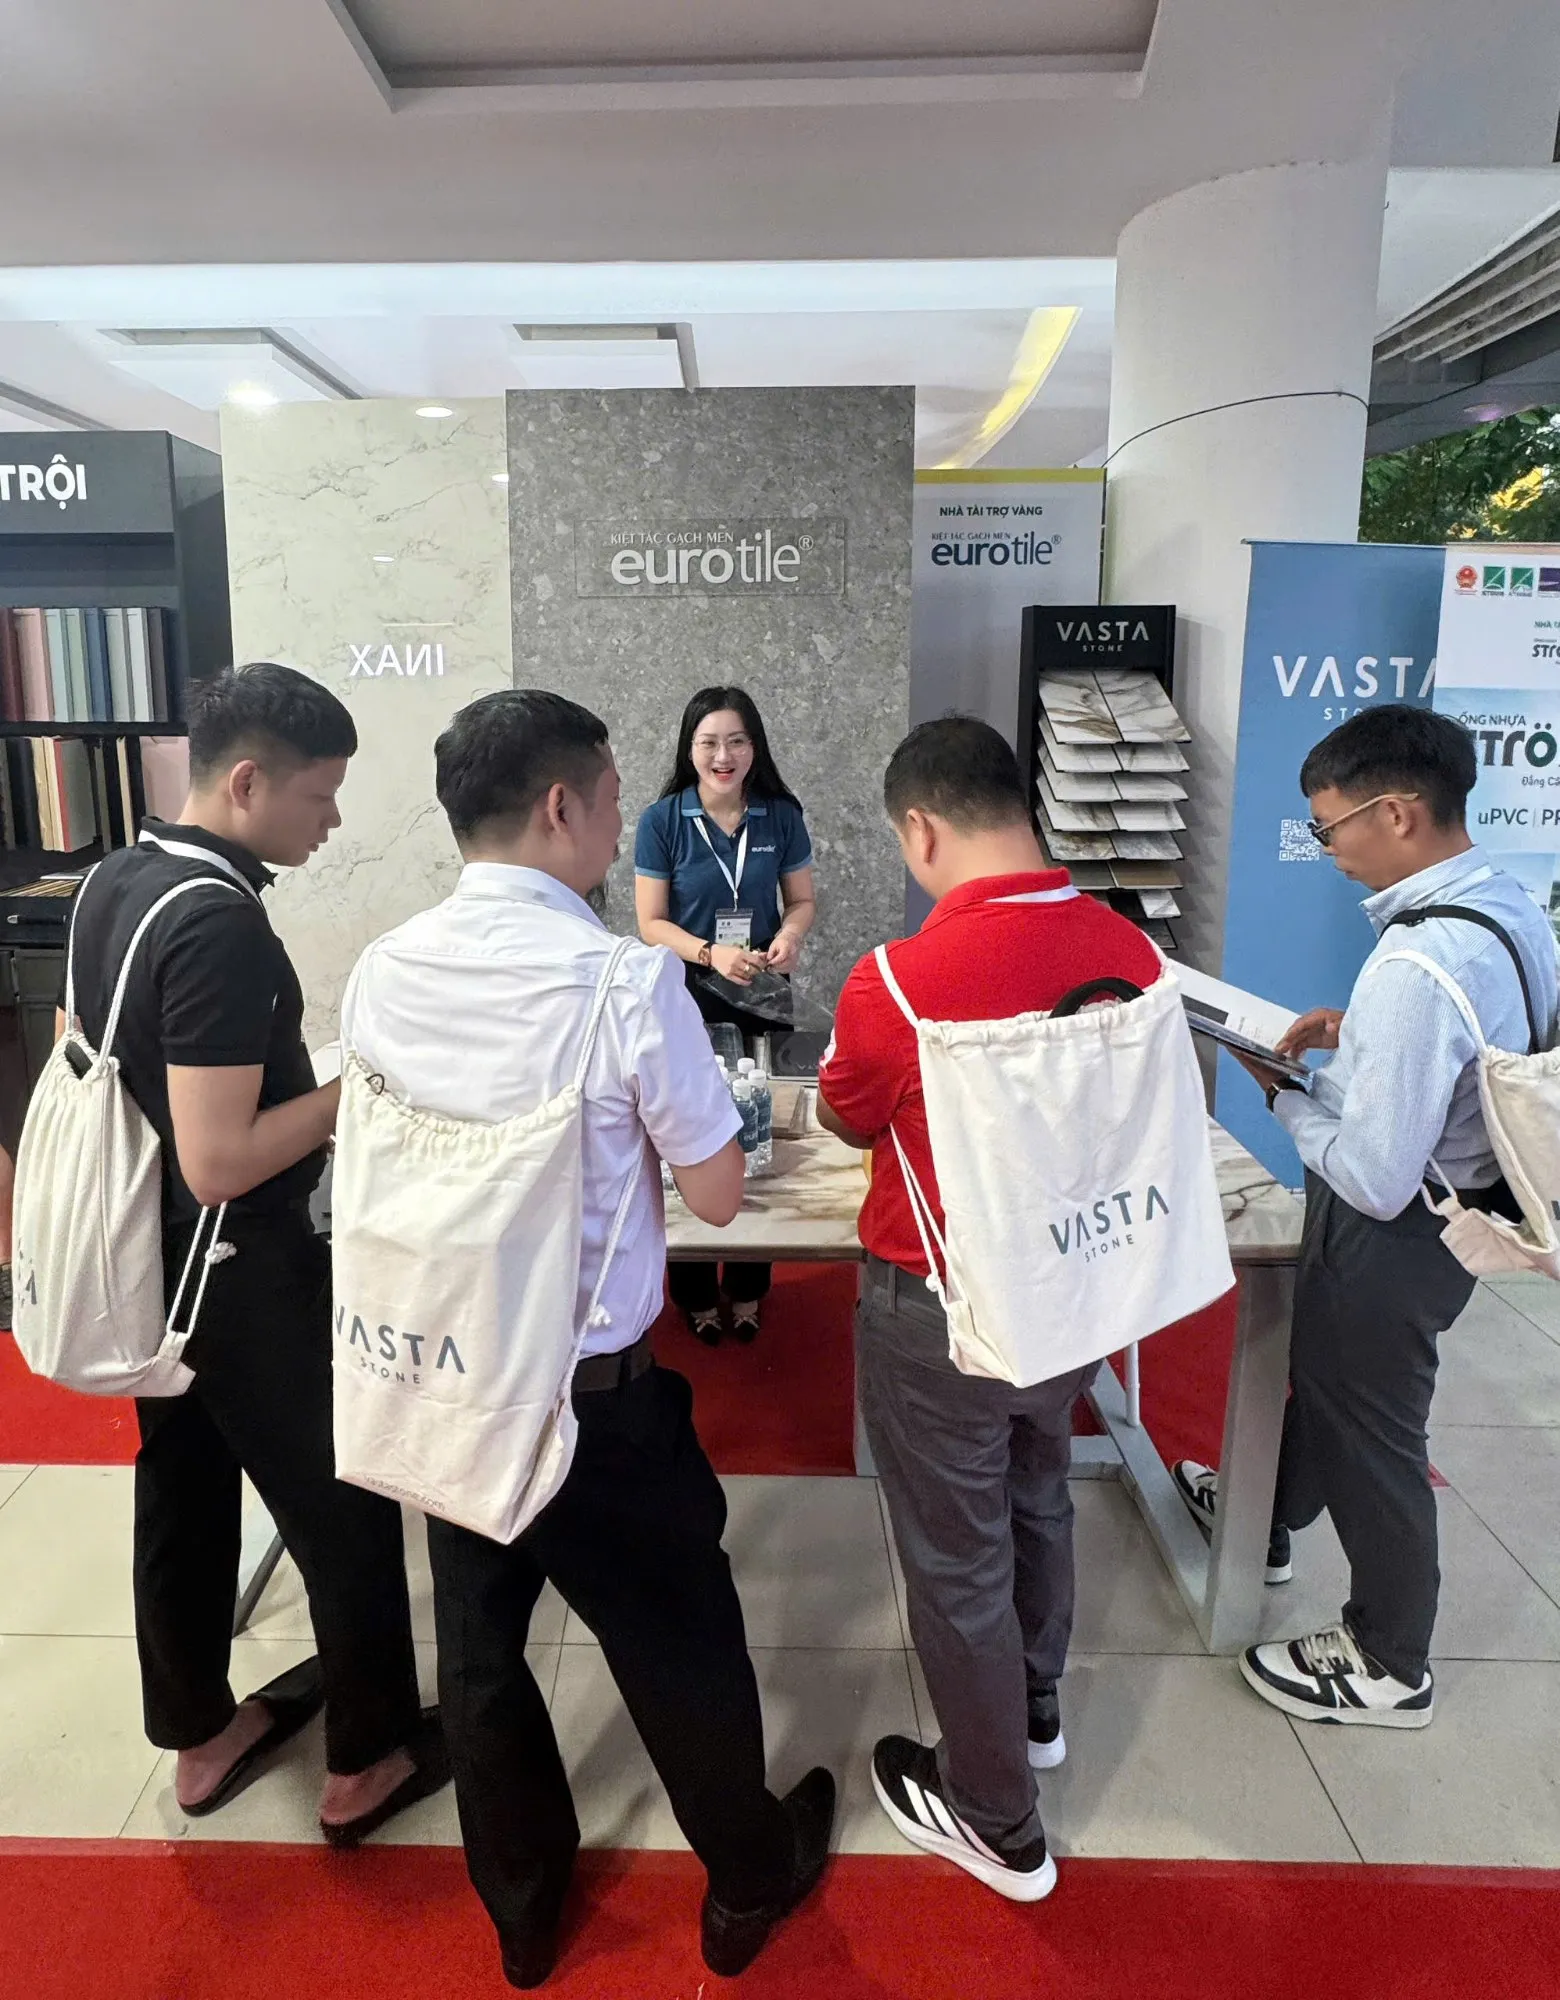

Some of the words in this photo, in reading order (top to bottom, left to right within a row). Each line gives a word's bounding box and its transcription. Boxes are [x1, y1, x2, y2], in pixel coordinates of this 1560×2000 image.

[0, 453, 87, 510] TRỘI
[940, 504, 964, 516] NHÀ
[967, 504, 983, 516] TÀI
[986, 505, 1010, 518] TRỢ
[1012, 504, 1043, 516] VÀNG
[639, 531, 663, 545] TÁC
[667, 531, 702, 545] GẠCH
[706, 531, 734, 544] MEN
[1056, 621, 1150, 641] VASTA
[1082, 644, 1123, 652] STONE
[1459, 711, 1486, 725] ỐNG
[1489, 714, 1527, 727] NHỰA
[1478, 808, 1528, 825] uPVC
[1048, 1185, 1169, 1255] VASTA
[1085, 1234, 1134, 1263] STONE
[334, 1305, 466, 1374] VASTA
[361, 1356, 421, 1384] STONE
